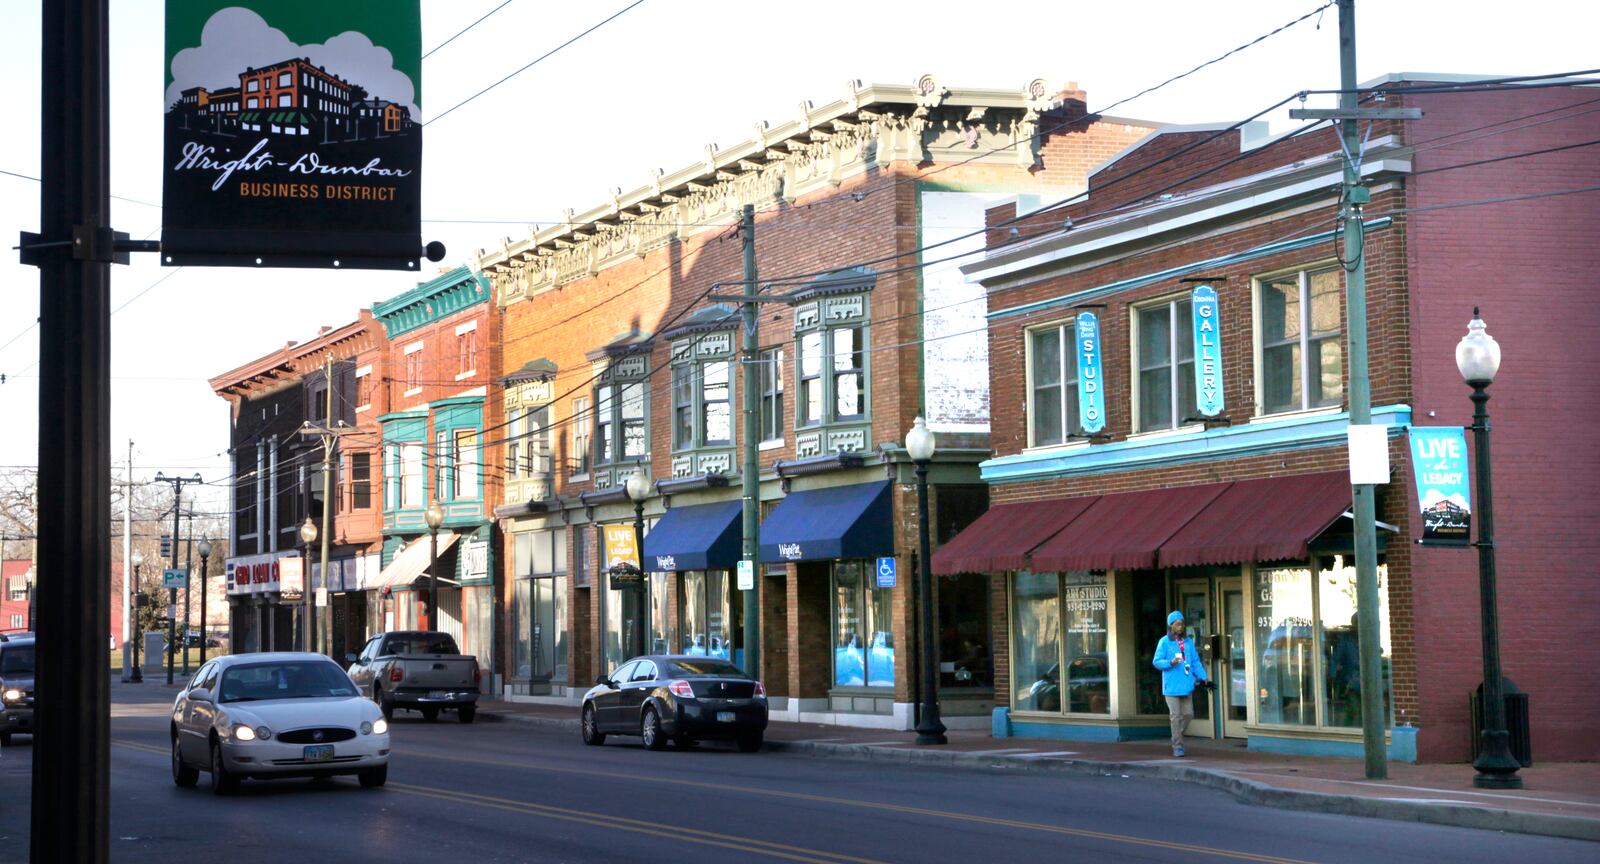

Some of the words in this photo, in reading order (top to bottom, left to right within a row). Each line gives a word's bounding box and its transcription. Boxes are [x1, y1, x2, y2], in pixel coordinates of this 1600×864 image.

[174, 138, 412, 191] Wright-Dunbar
[240, 182, 319, 199] BUSINESS
[326, 185, 396, 201] DISTRICT
[1199, 305, 1216, 403] GALLERY
[1083, 340, 1098, 420] STUDIO
[1418, 438, 1460, 458] LIVE
[1423, 472, 1462, 484] LEGACY
[608, 530, 632, 541] LIVE
[164, 571, 174, 585] P
[1080, 587, 1107, 599] STUDIO
